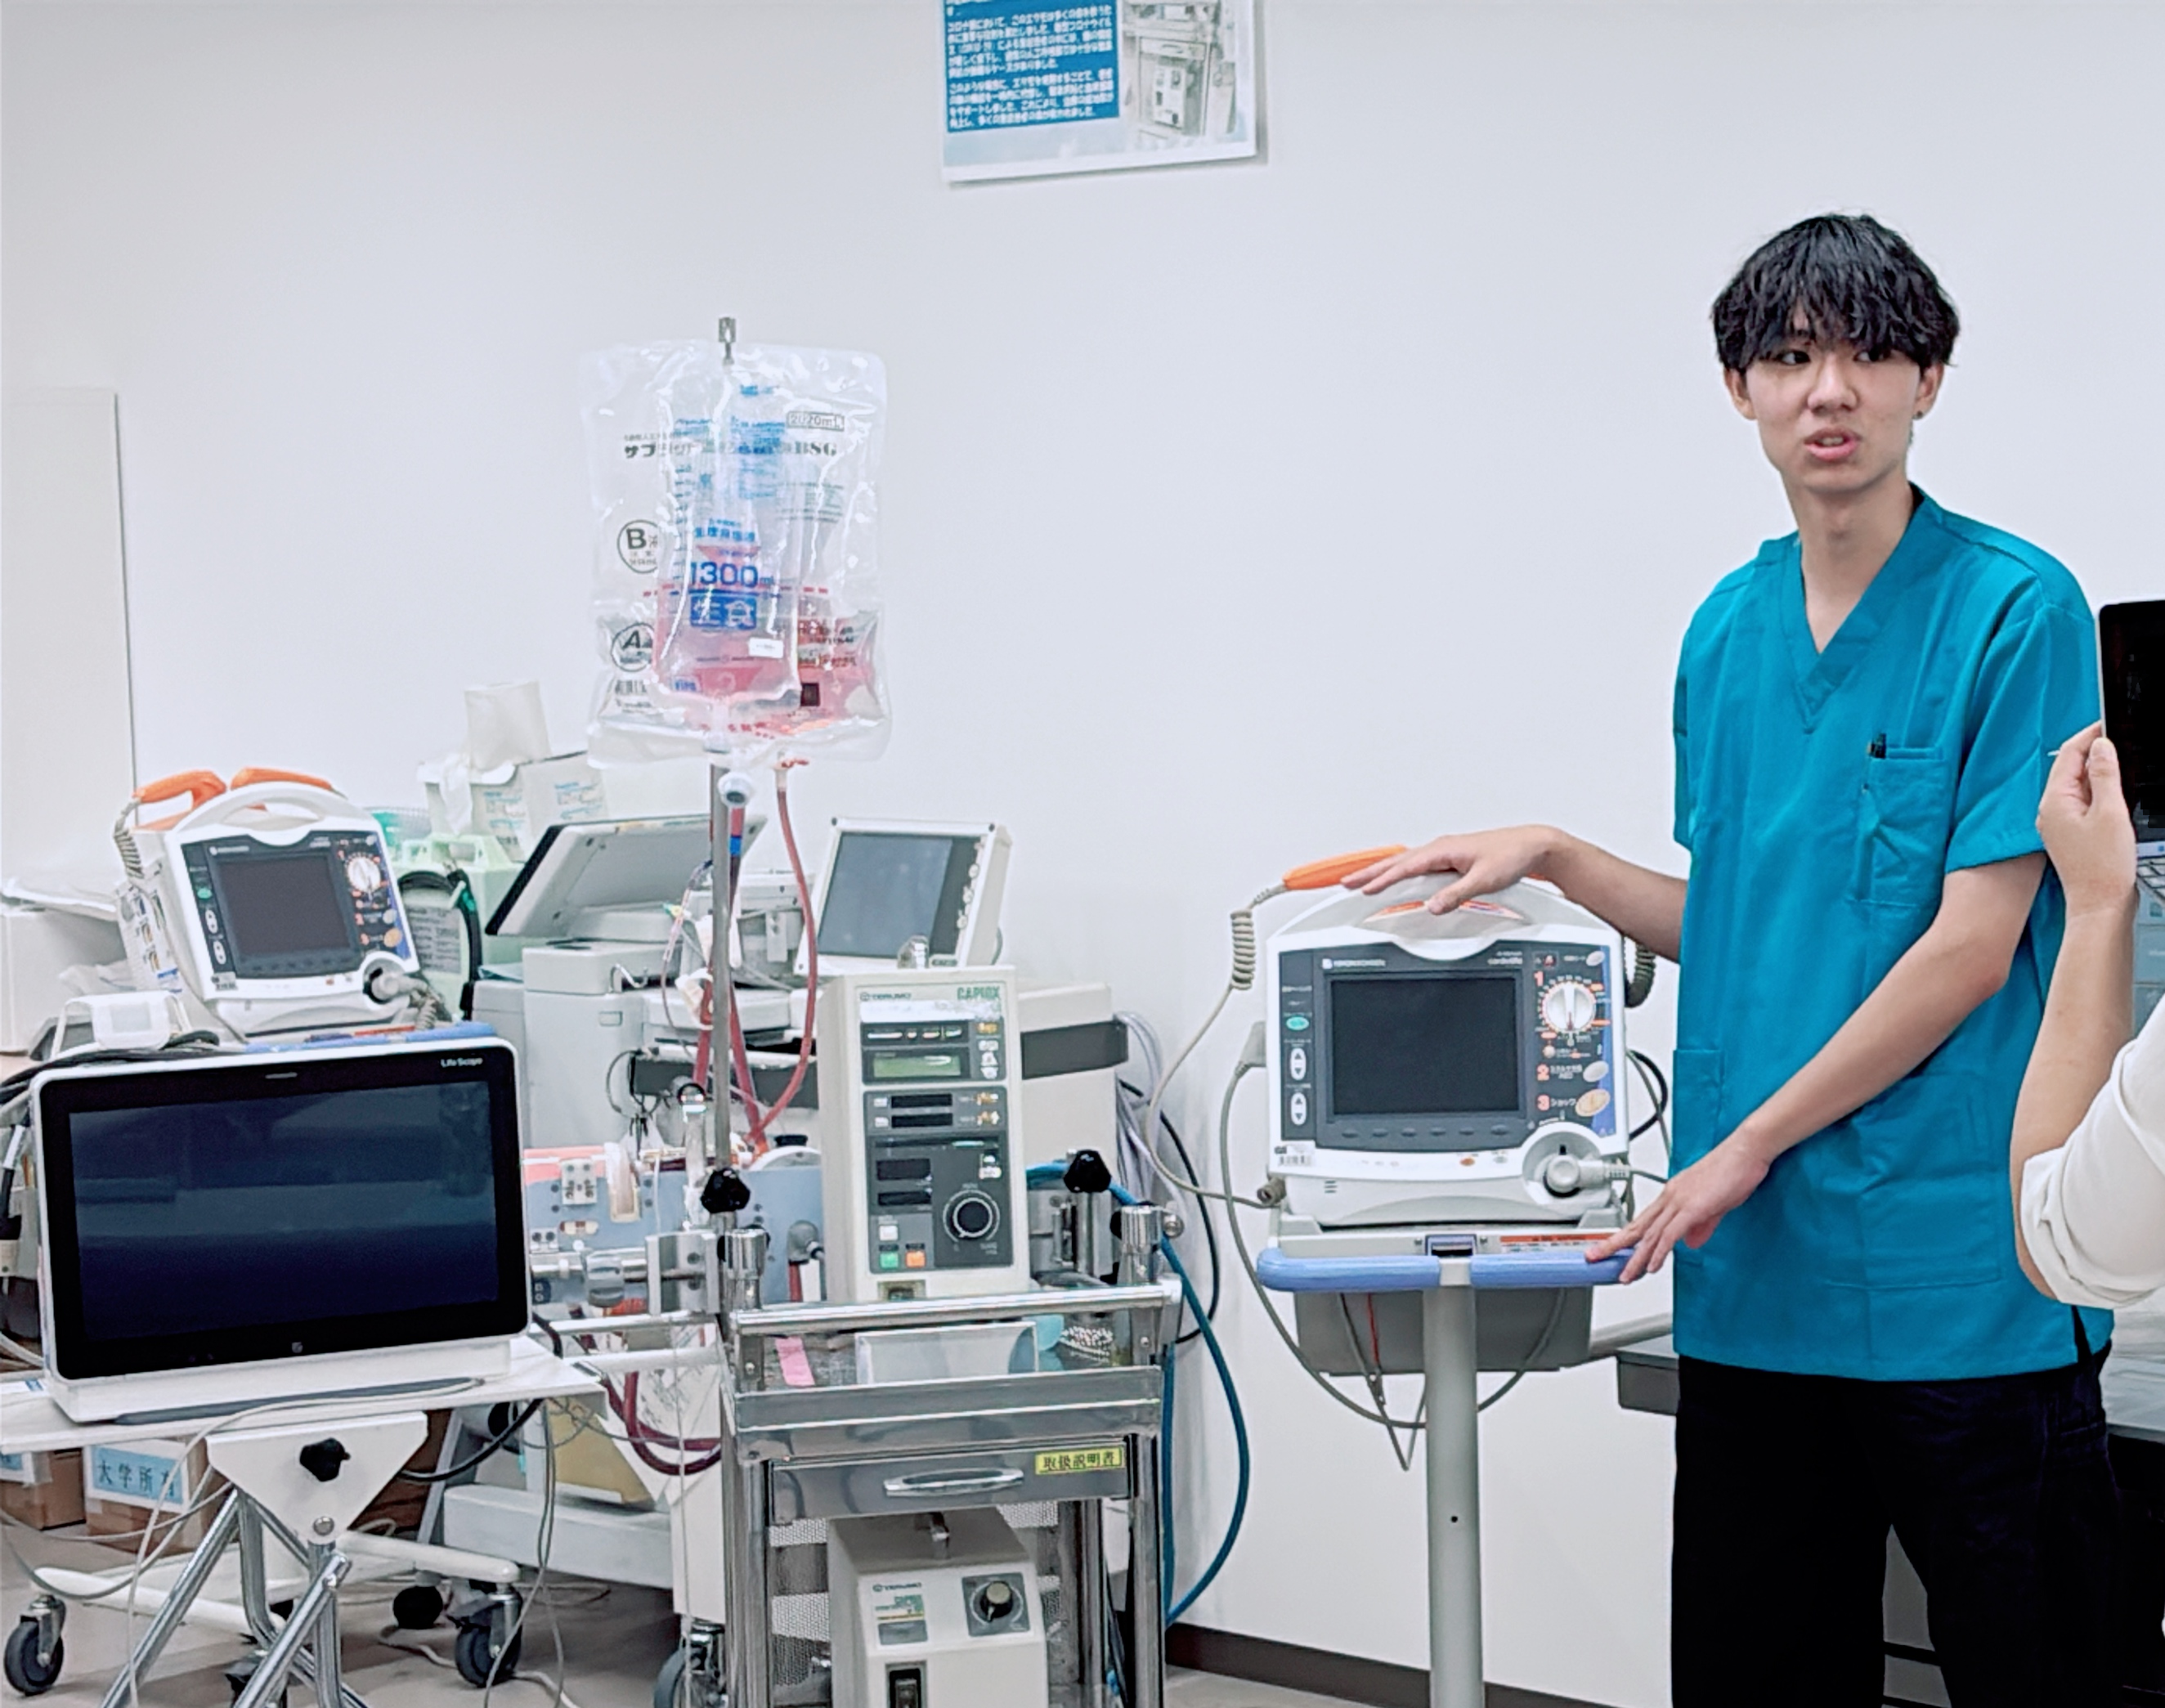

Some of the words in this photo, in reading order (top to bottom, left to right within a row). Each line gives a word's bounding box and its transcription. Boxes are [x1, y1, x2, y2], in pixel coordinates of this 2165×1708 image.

[691, 562, 759, 588] 1300
[1534, 971, 1544, 987] 1
[1536, 1064, 1550, 1081] 2
[1536, 1095, 1550, 1111] 3
[1044, 1451, 1114, 1471] 取扱説明書
